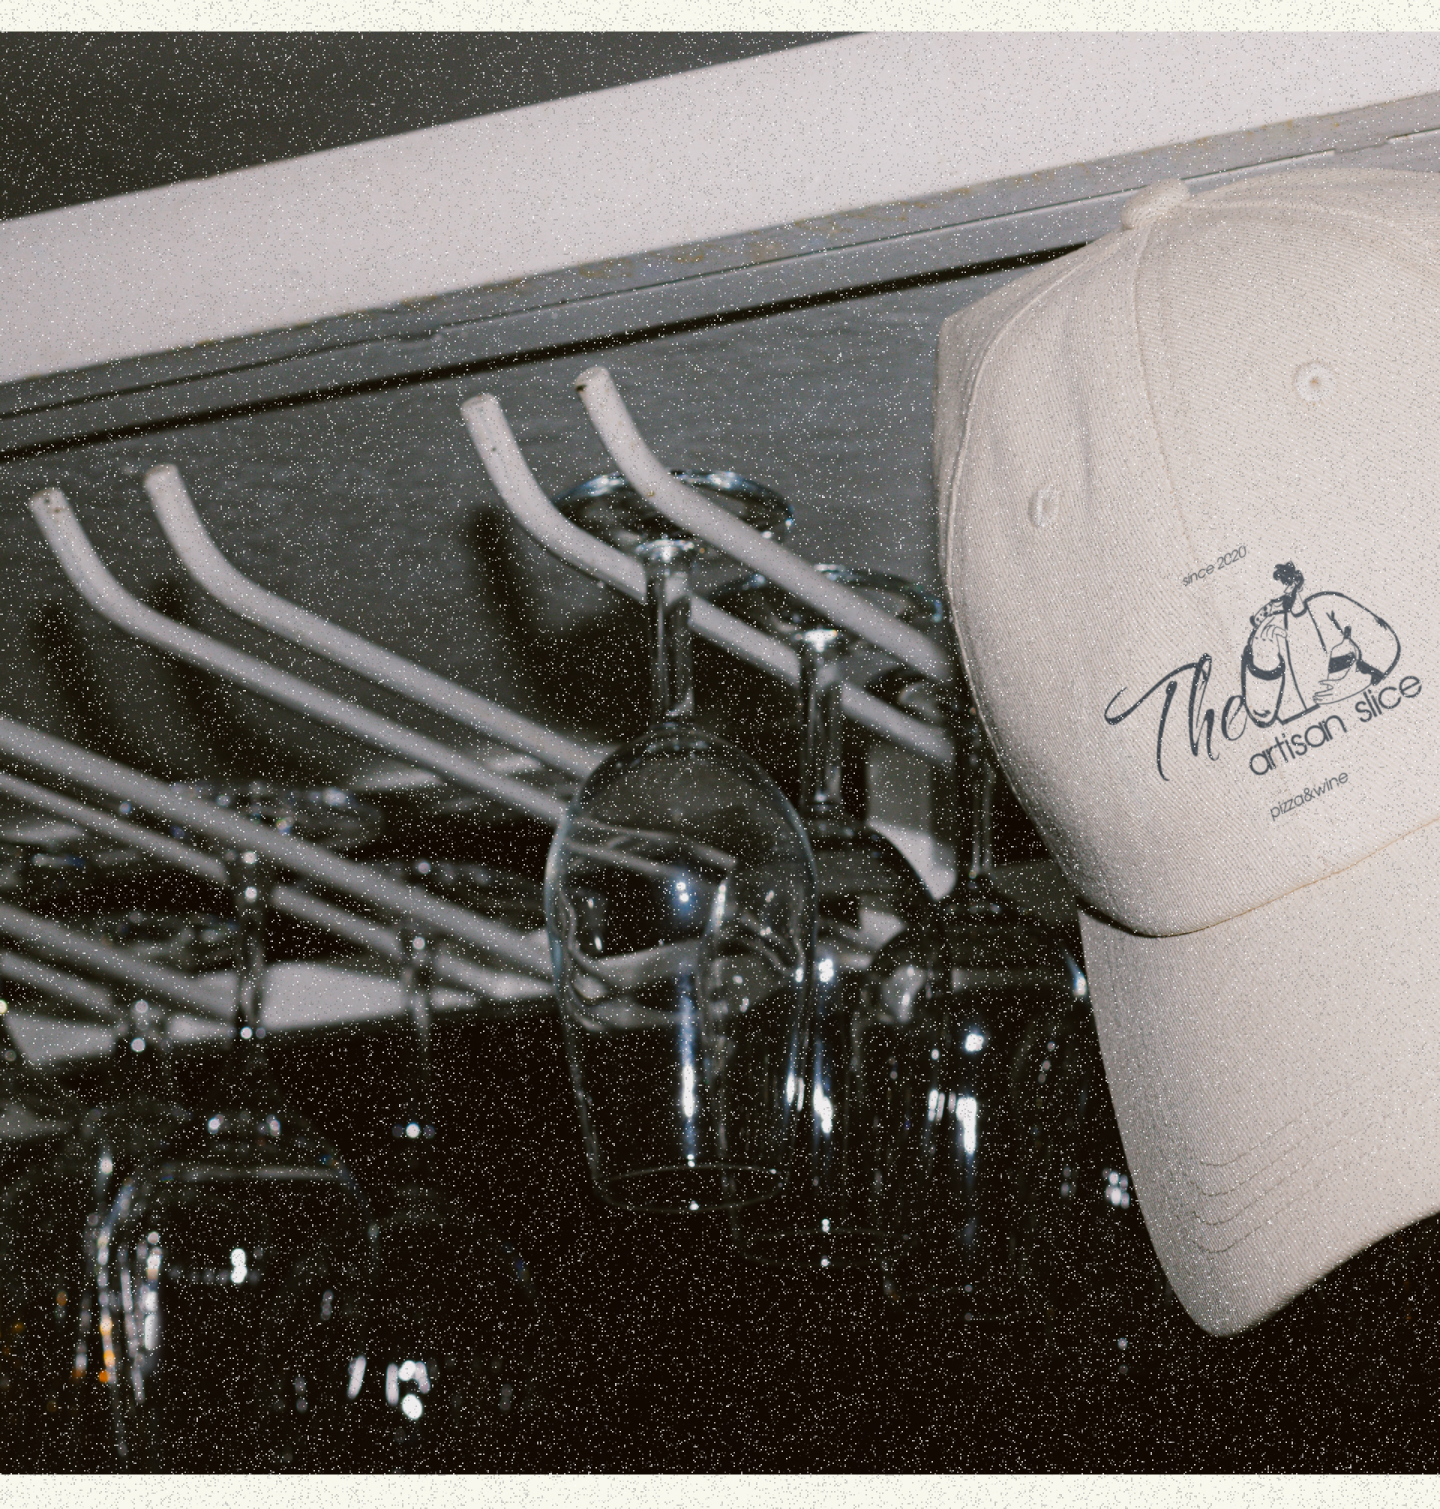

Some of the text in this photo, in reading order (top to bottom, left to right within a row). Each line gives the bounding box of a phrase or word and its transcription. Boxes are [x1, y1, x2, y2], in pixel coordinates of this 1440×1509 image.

[1182, 545, 1249, 588] since 2020
[1104, 652, 1247, 781] The
[1249, 675, 1423, 776] artisan slice
[1269, 771, 1350, 822] pizza&wine
